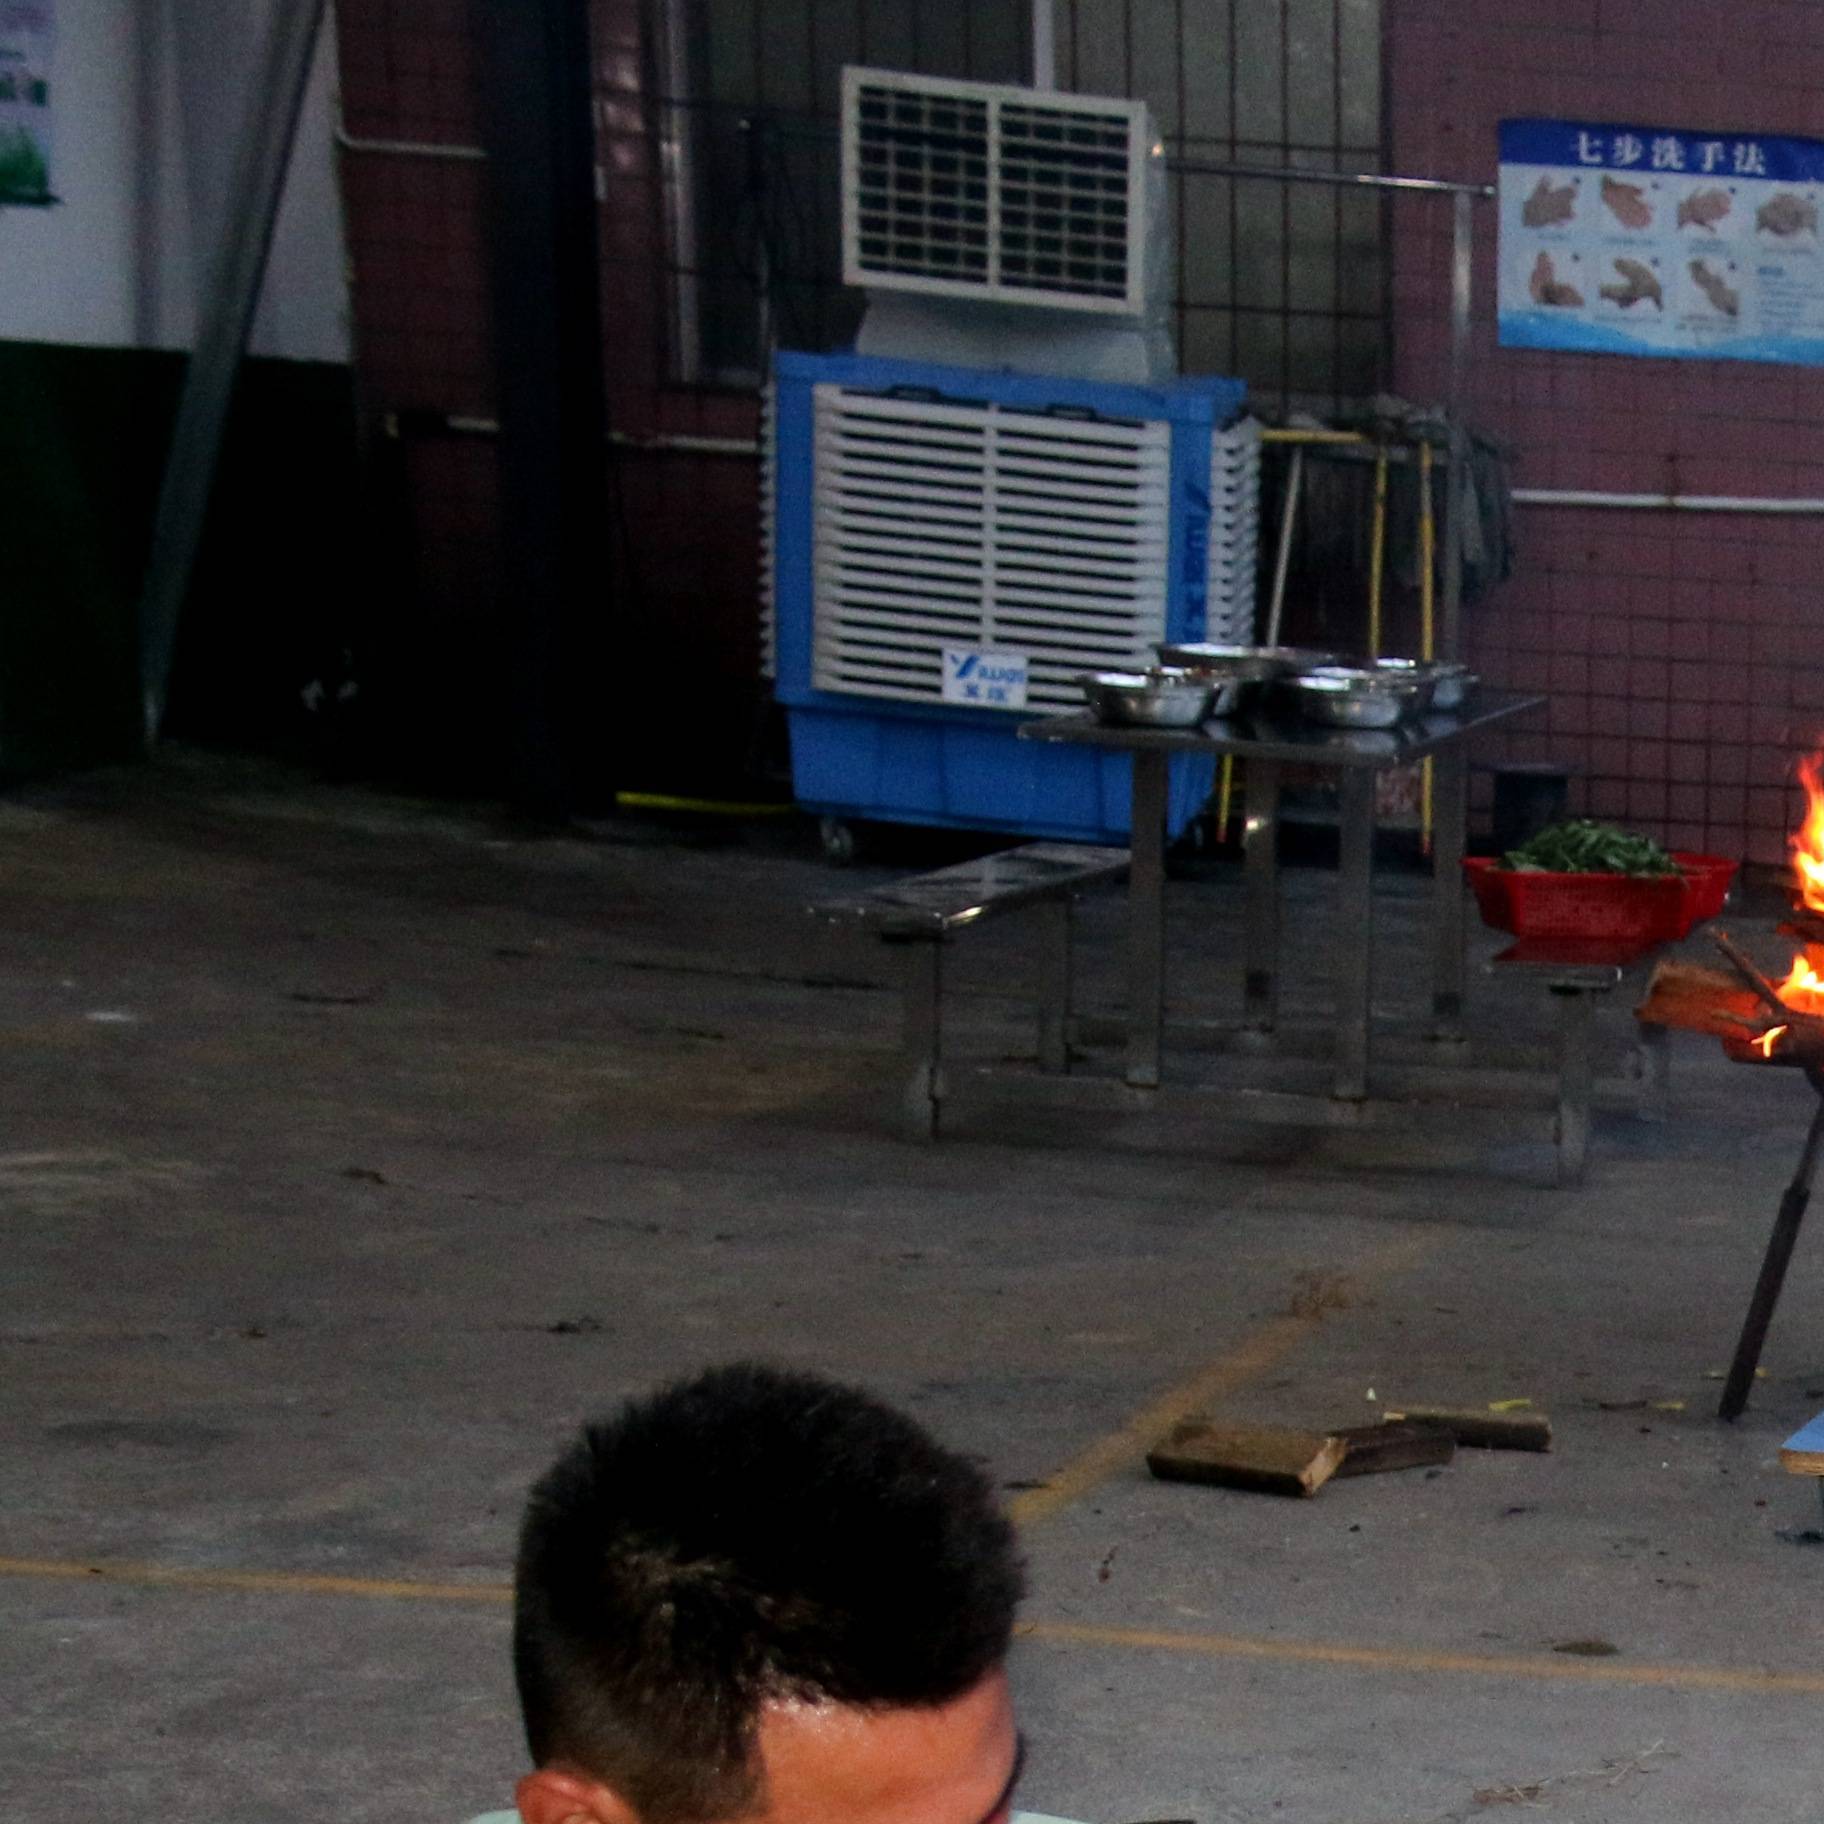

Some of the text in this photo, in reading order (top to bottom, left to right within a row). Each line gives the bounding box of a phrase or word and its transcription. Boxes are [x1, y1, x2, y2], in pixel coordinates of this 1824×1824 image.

[1576, 130, 1766, 176] 七步洗手法
